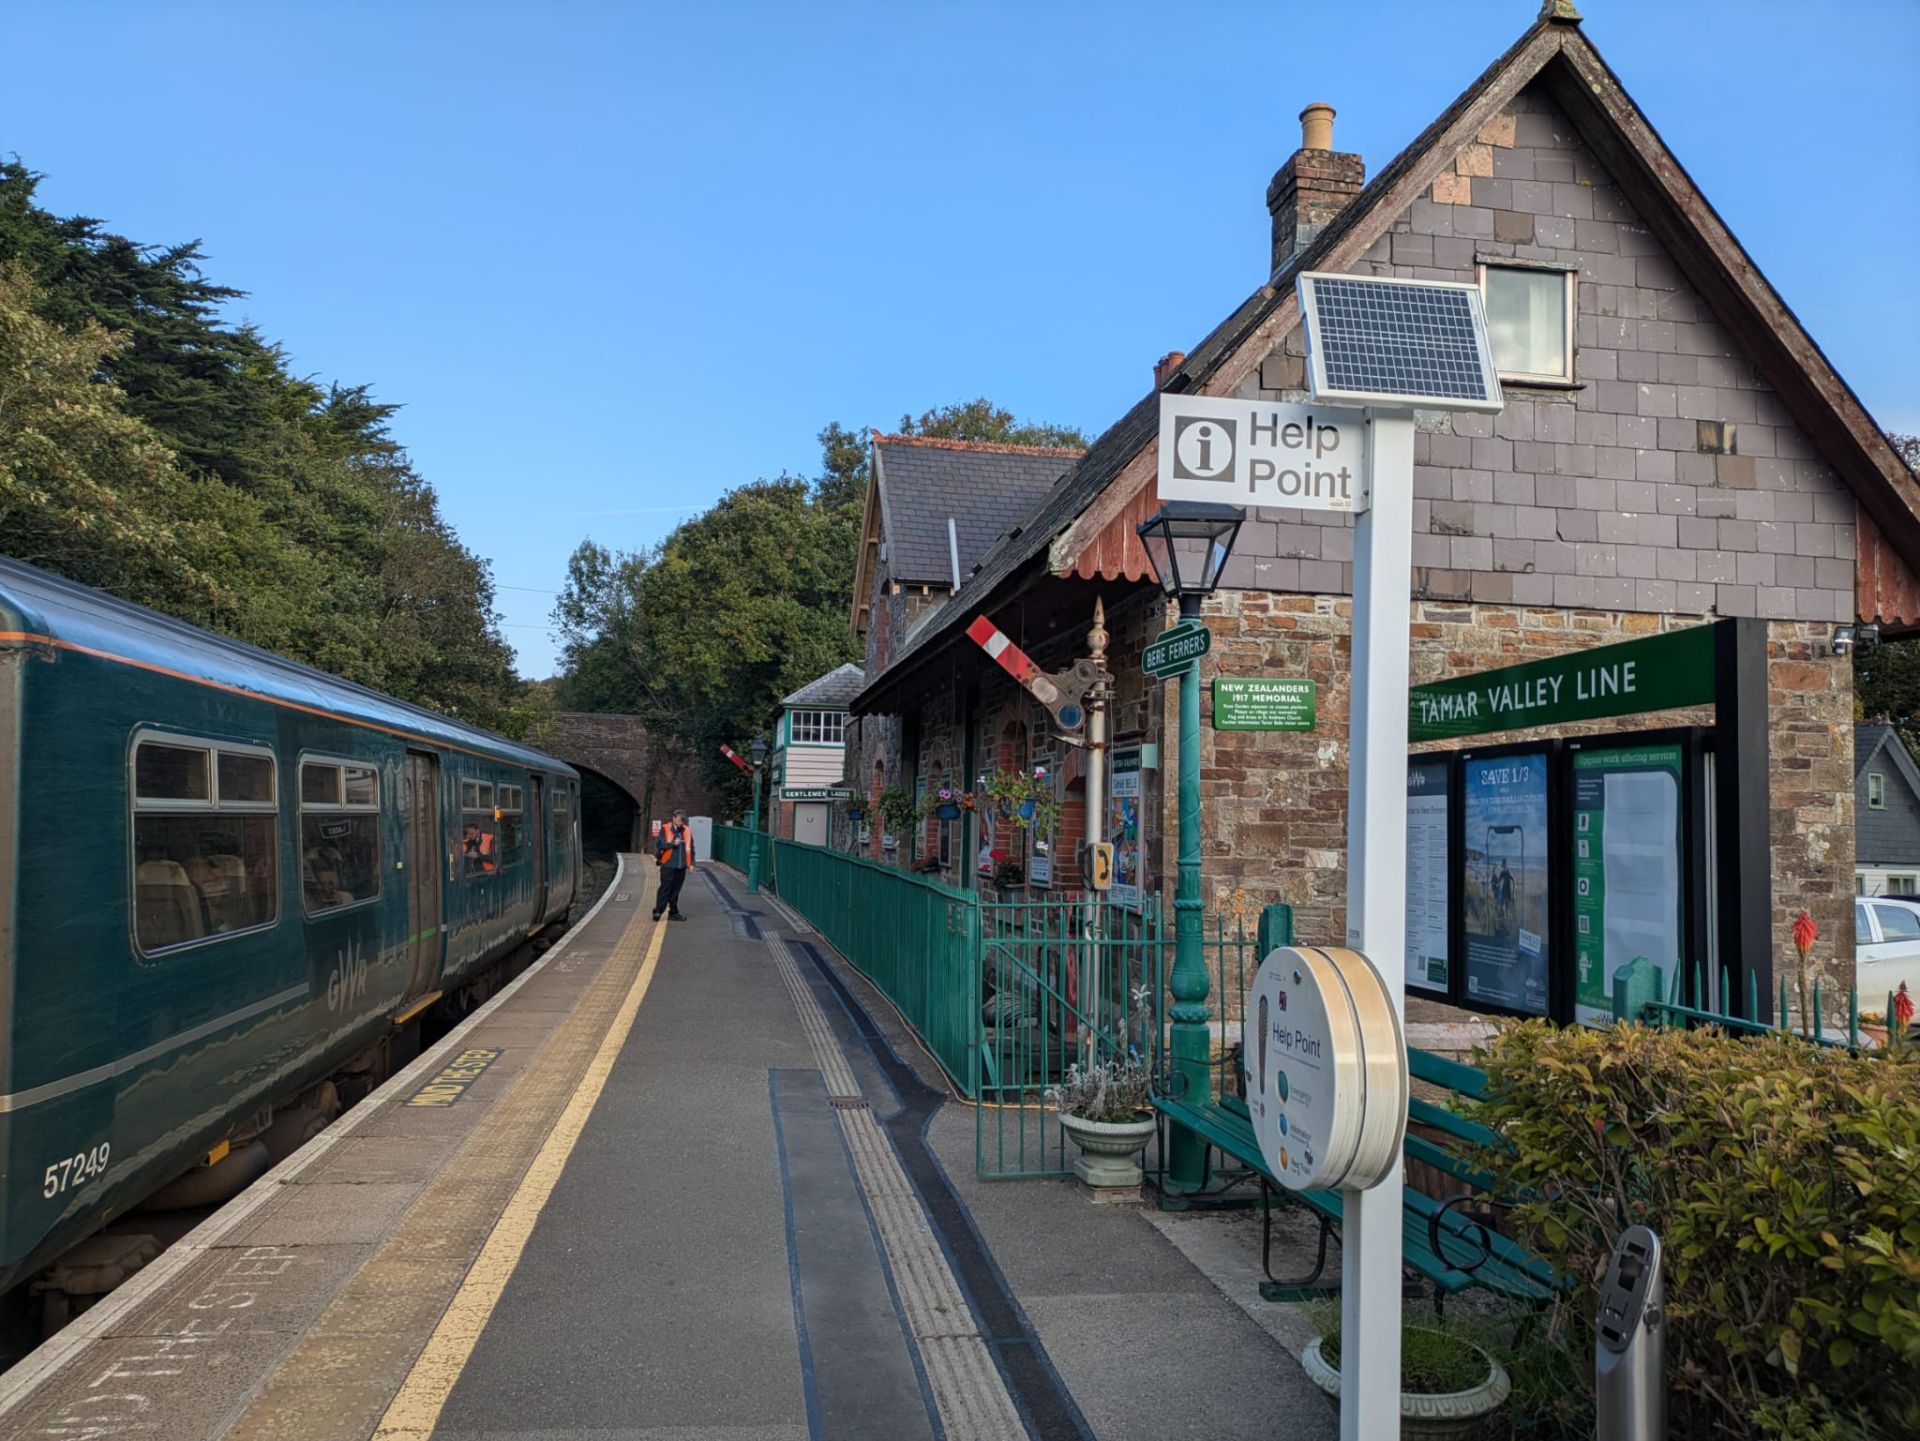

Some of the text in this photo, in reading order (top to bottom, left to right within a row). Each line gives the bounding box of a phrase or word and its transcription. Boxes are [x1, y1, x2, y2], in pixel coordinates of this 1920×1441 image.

[1250, 411, 1340, 459] Help
[1249, 458, 1351, 498] Point
[1147, 633, 1205, 668] BERE FERRERS
[1221, 684, 1309, 693] NEW ZEALANDERS
[1232, 694, 1302, 703] 1917 MEMORIAL
[1419, 691, 1478, 724] TAMAR
[1487, 675, 1563, 713] VALLEY
[1577, 661, 1636, 700] LINE
[1481, 766, 1529, 785] SAVE 1/3
[1649, 752, 1677, 761] services
[327, 935, 368, 1017] GWR
[1272, 1021, 1321, 1058] Help Point
[406, 1049, 499, 1106] MIND THE STEP
[43, 1141, 111, 1199] 57249
[88, 1317, 235, 1388] THE
[189, 1246, 298, 1309] STEP
